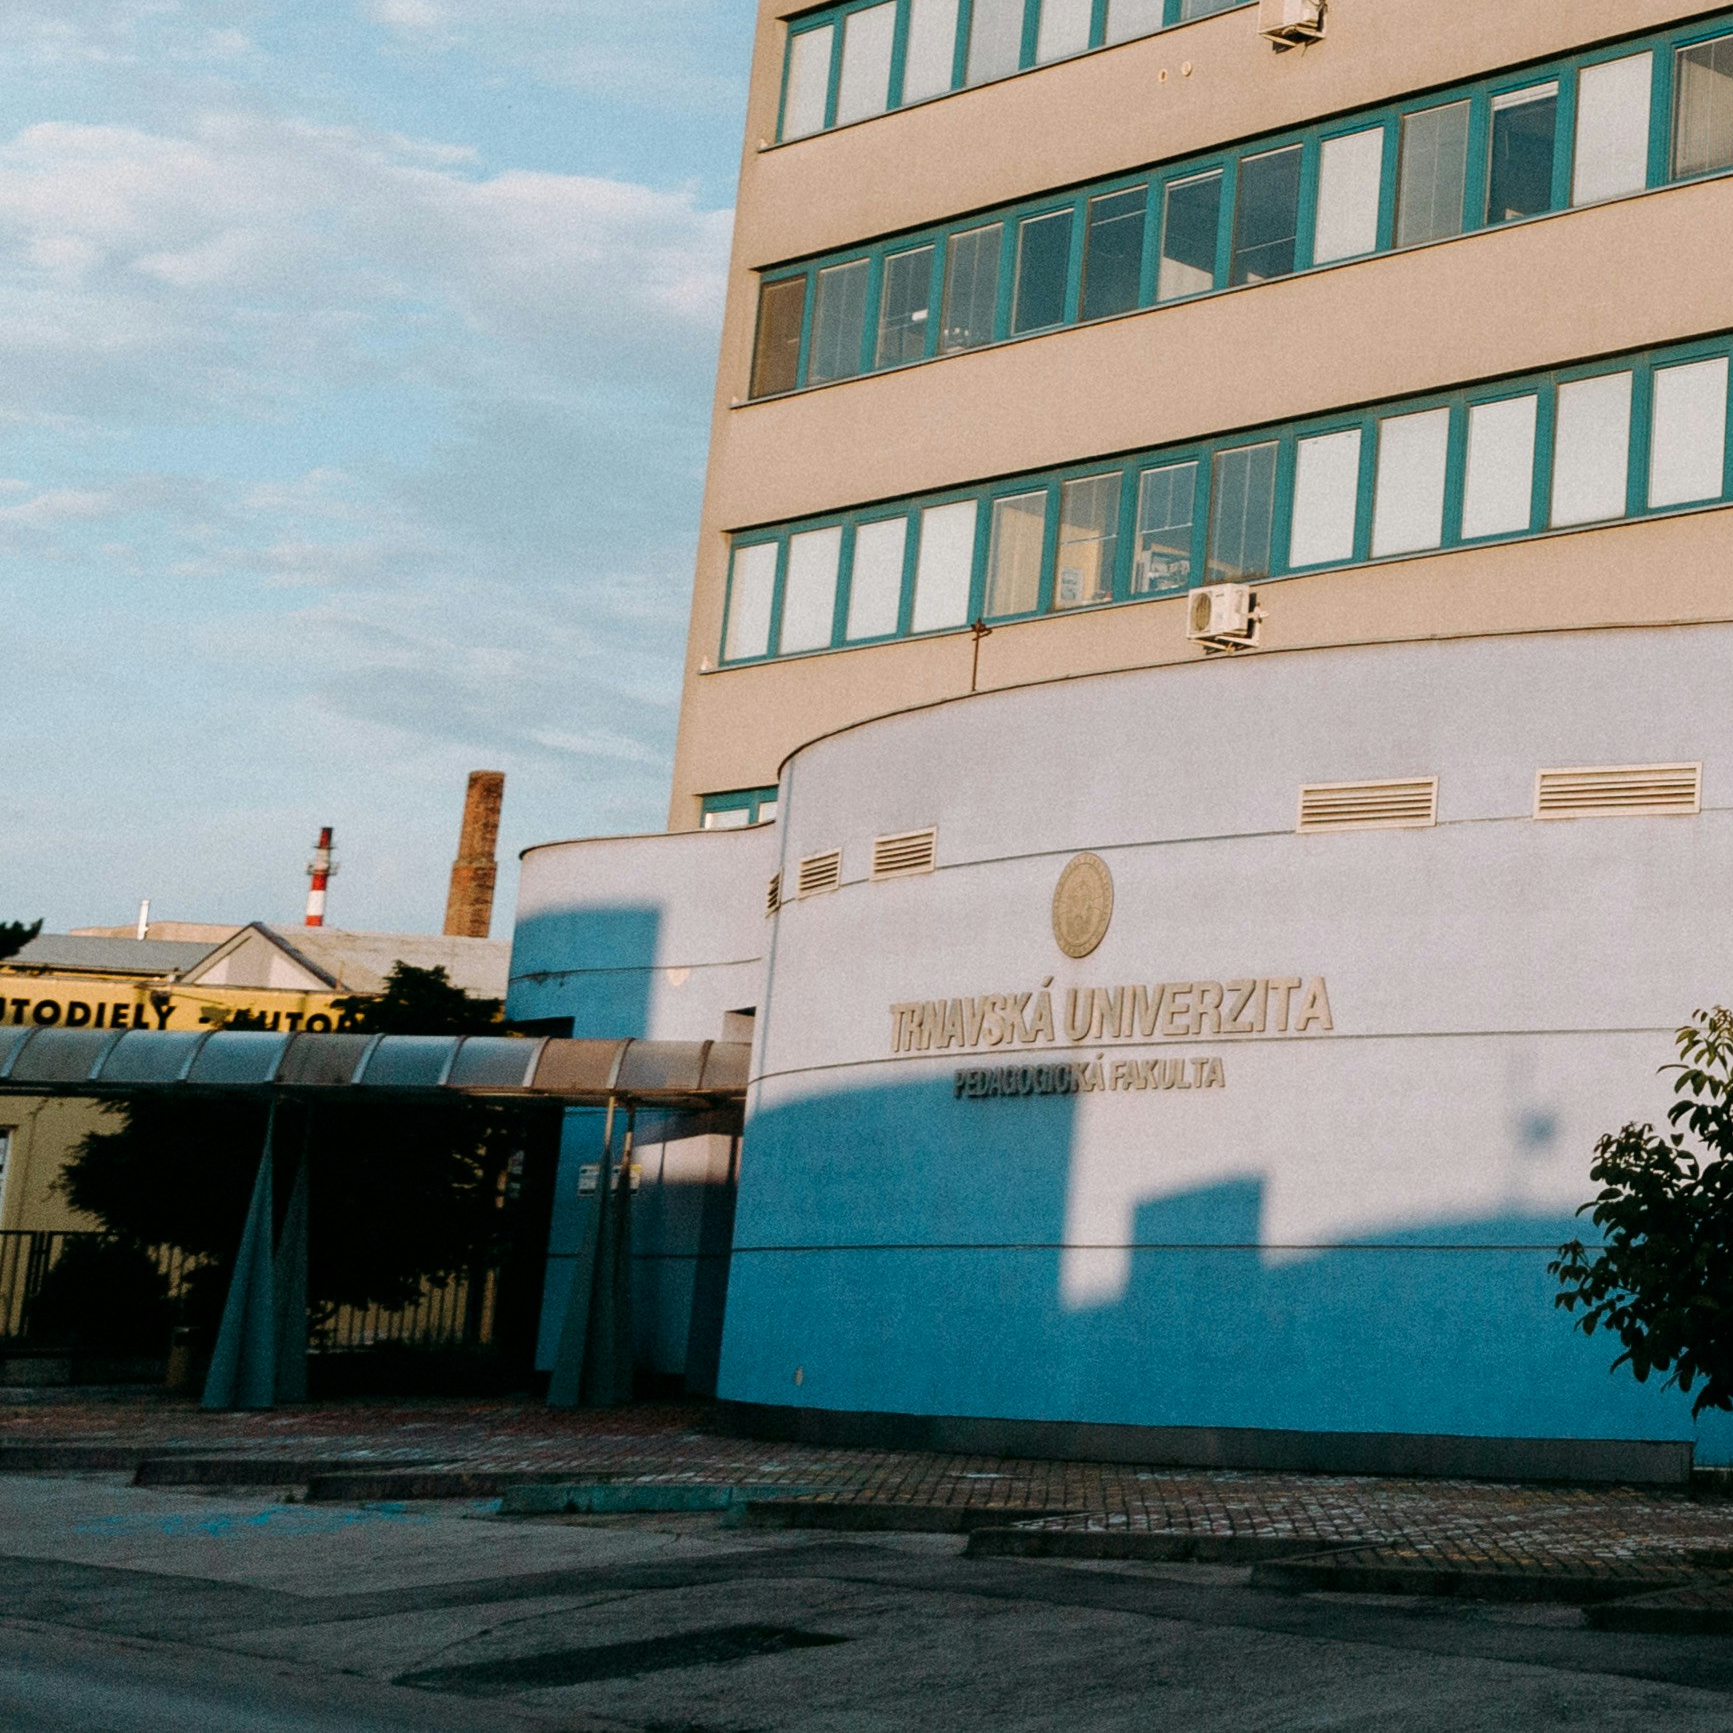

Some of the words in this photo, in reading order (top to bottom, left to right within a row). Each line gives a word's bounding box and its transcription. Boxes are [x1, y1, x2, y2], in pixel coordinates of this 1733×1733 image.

[0, 997, 177, 1030] TODIELY
[889, 975, 1055, 1052] TRNAVSKÁ
[1062, 976, 1334, 1042] UNIVERZITA
[953, 1053, 1105, 1099] PEDAGOGICKÁ
[1108, 1057, 1226, 1091] FAKULTA
